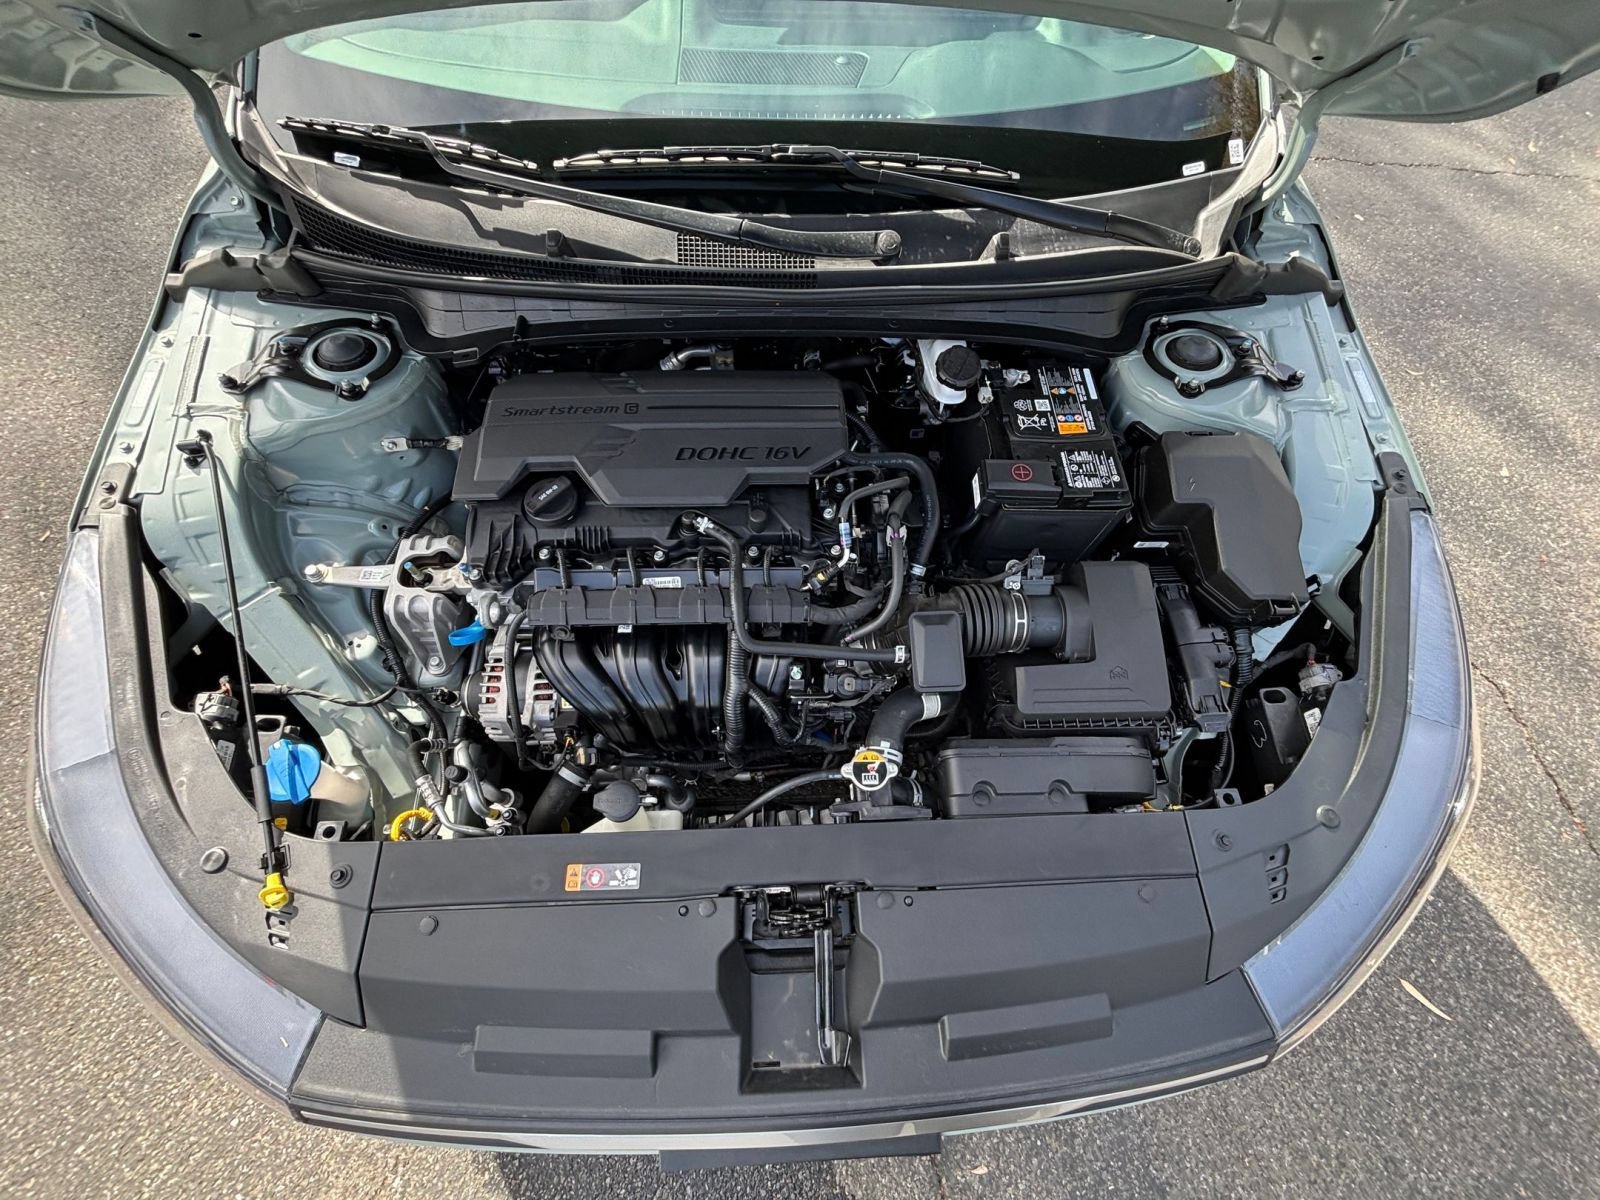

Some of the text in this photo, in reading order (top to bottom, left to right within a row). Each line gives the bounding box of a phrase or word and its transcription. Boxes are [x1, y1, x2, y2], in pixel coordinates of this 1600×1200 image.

[501, 405, 619, 417] Smartstream
[675, 446, 812, 461] DOHC 16V
